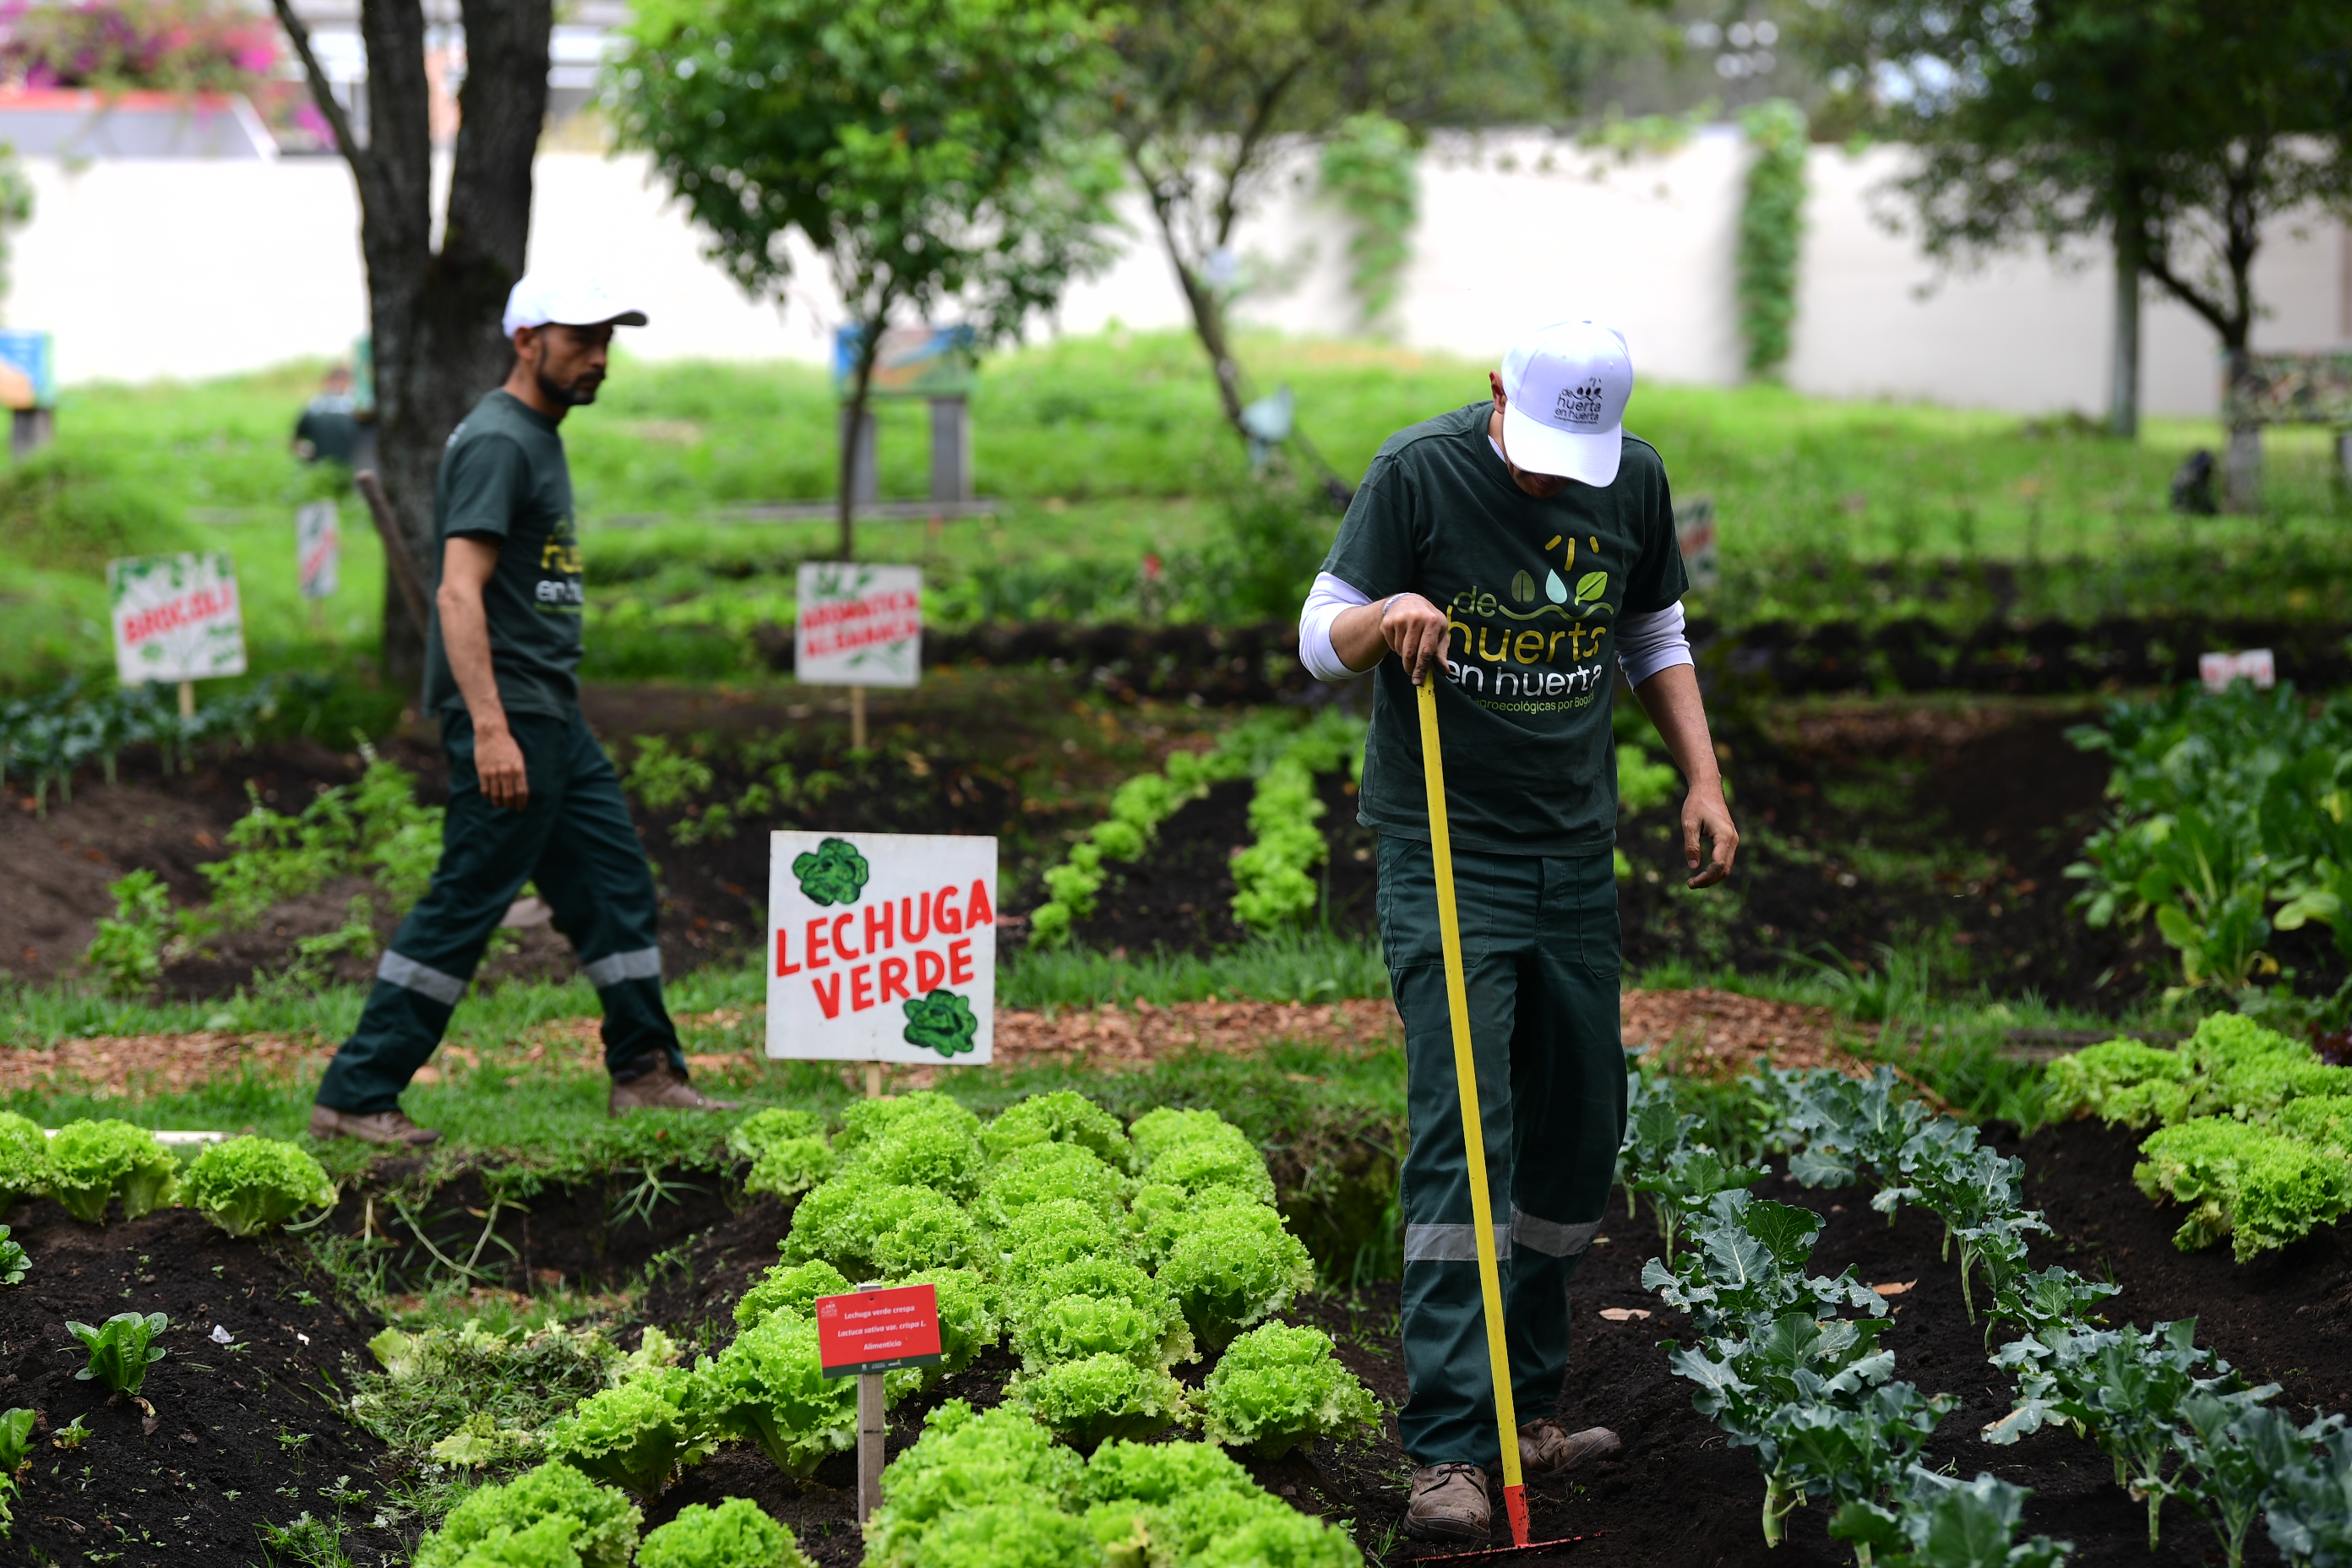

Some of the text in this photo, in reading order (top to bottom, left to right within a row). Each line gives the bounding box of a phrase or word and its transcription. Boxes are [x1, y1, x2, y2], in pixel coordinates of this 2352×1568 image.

[1561, 388, 1573, 398] de
[1556, 393, 1602, 412] huerta
[1554, 407, 1567, 417] en
[1568, 409, 1599, 421] huerta
[1452, 585, 1498, 618] de
[1446, 604, 1607, 665] huerta
[1446, 659, 1603, 697] en huerta
[1557, 700, 1574, 713] por
[776, 878, 994, 977] LECHUGA
[811, 938, 974, 1020] VERDE
[844, 1310, 872, 1320] Lechuga
[872, 1307, 892, 1316] verde
[892, 1305, 915, 1314] crespa
[837, 1328, 863, 1337] Lactuca
[863, 1326, 885, 1334] sativa
[899, 1320, 919, 1330] crispa
[863, 1339, 902, 1351] Alimenticio
